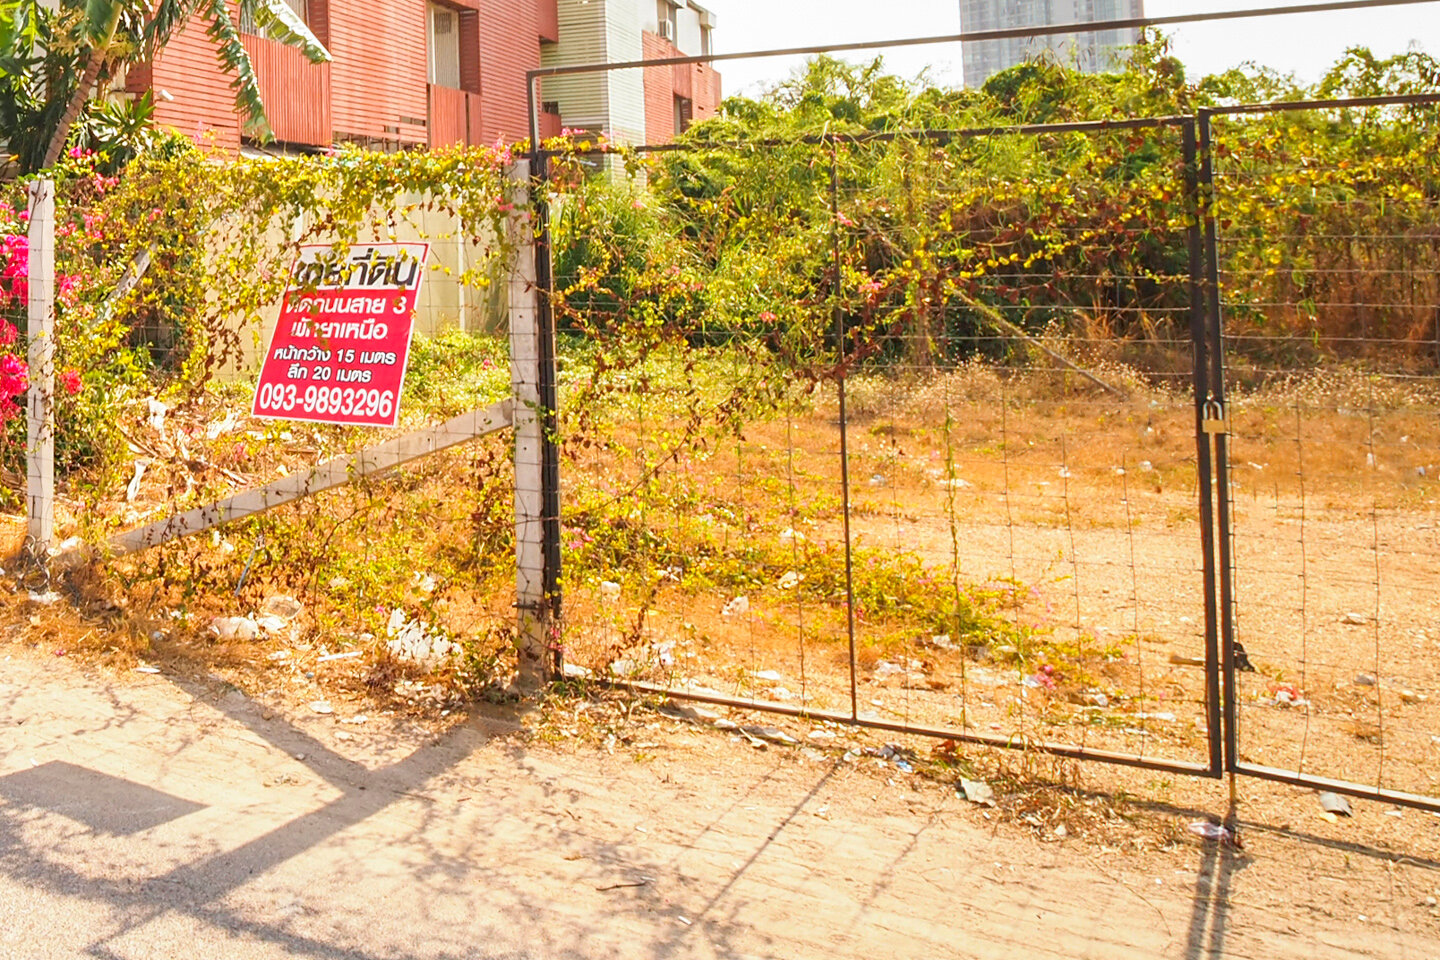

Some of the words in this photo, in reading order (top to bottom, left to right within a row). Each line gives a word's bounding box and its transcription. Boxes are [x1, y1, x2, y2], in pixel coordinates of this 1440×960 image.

[392, 296, 407, 314] 3
[274, 345, 331, 362] หน้ากว้าง
[337, 349, 355, 363] 15
[360, 351, 396, 365] เมตร
[287, 363, 308, 379] ลึก
[312, 366, 331, 381] 20
[336, 368, 372, 383] เมตร
[260, 383, 394, 418] 093-9893296
